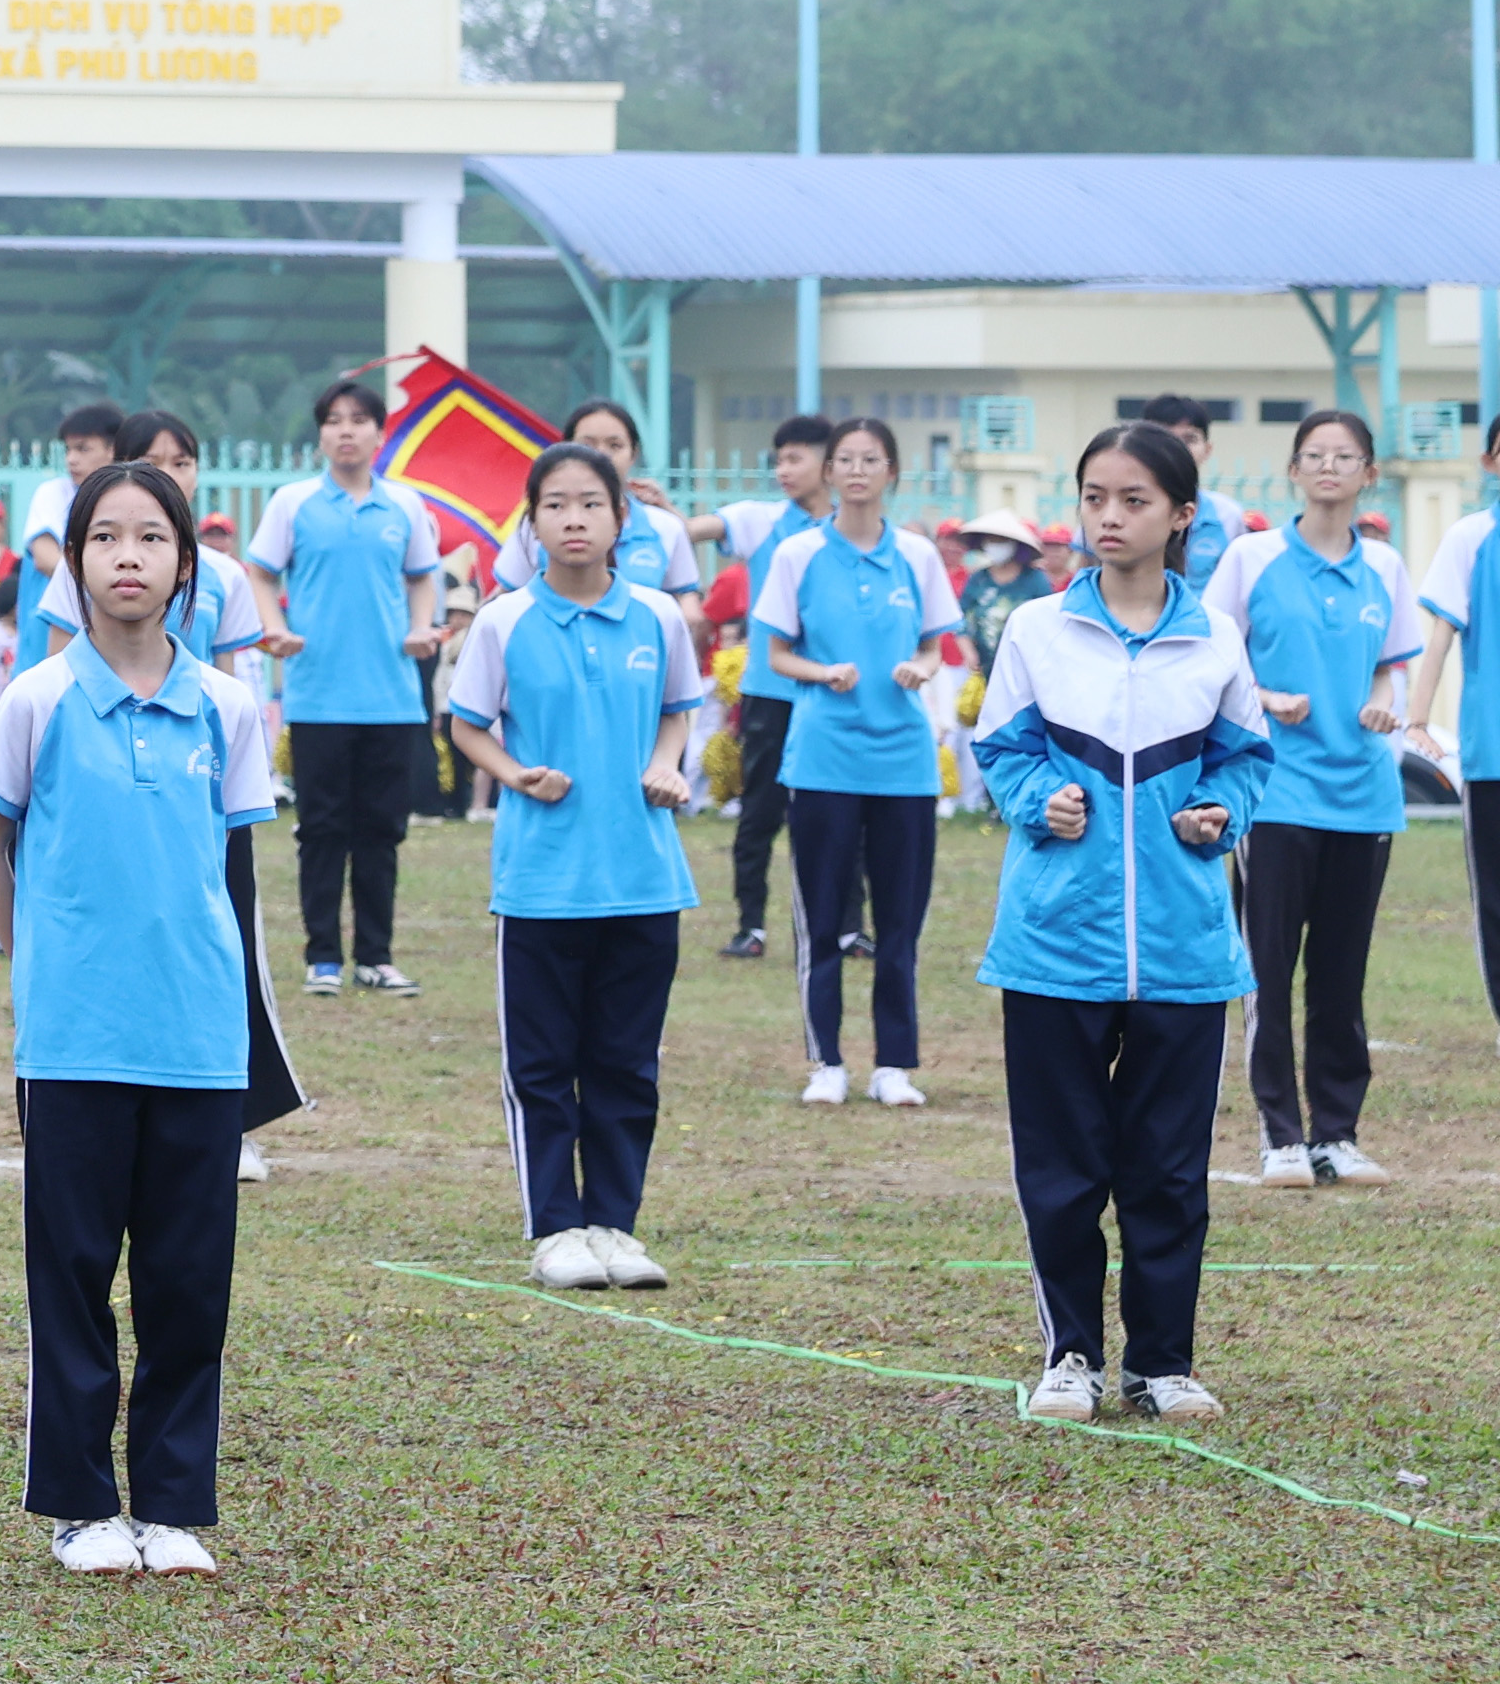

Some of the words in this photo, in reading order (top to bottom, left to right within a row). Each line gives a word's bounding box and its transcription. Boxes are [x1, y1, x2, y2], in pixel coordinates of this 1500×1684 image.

[8, 0, 91, 36] DỊCH
[103, 1, 149, 41] VỤ
[270, 1, 343, 44] HỢP
[138, 46, 258, 82] LƯƠNG
